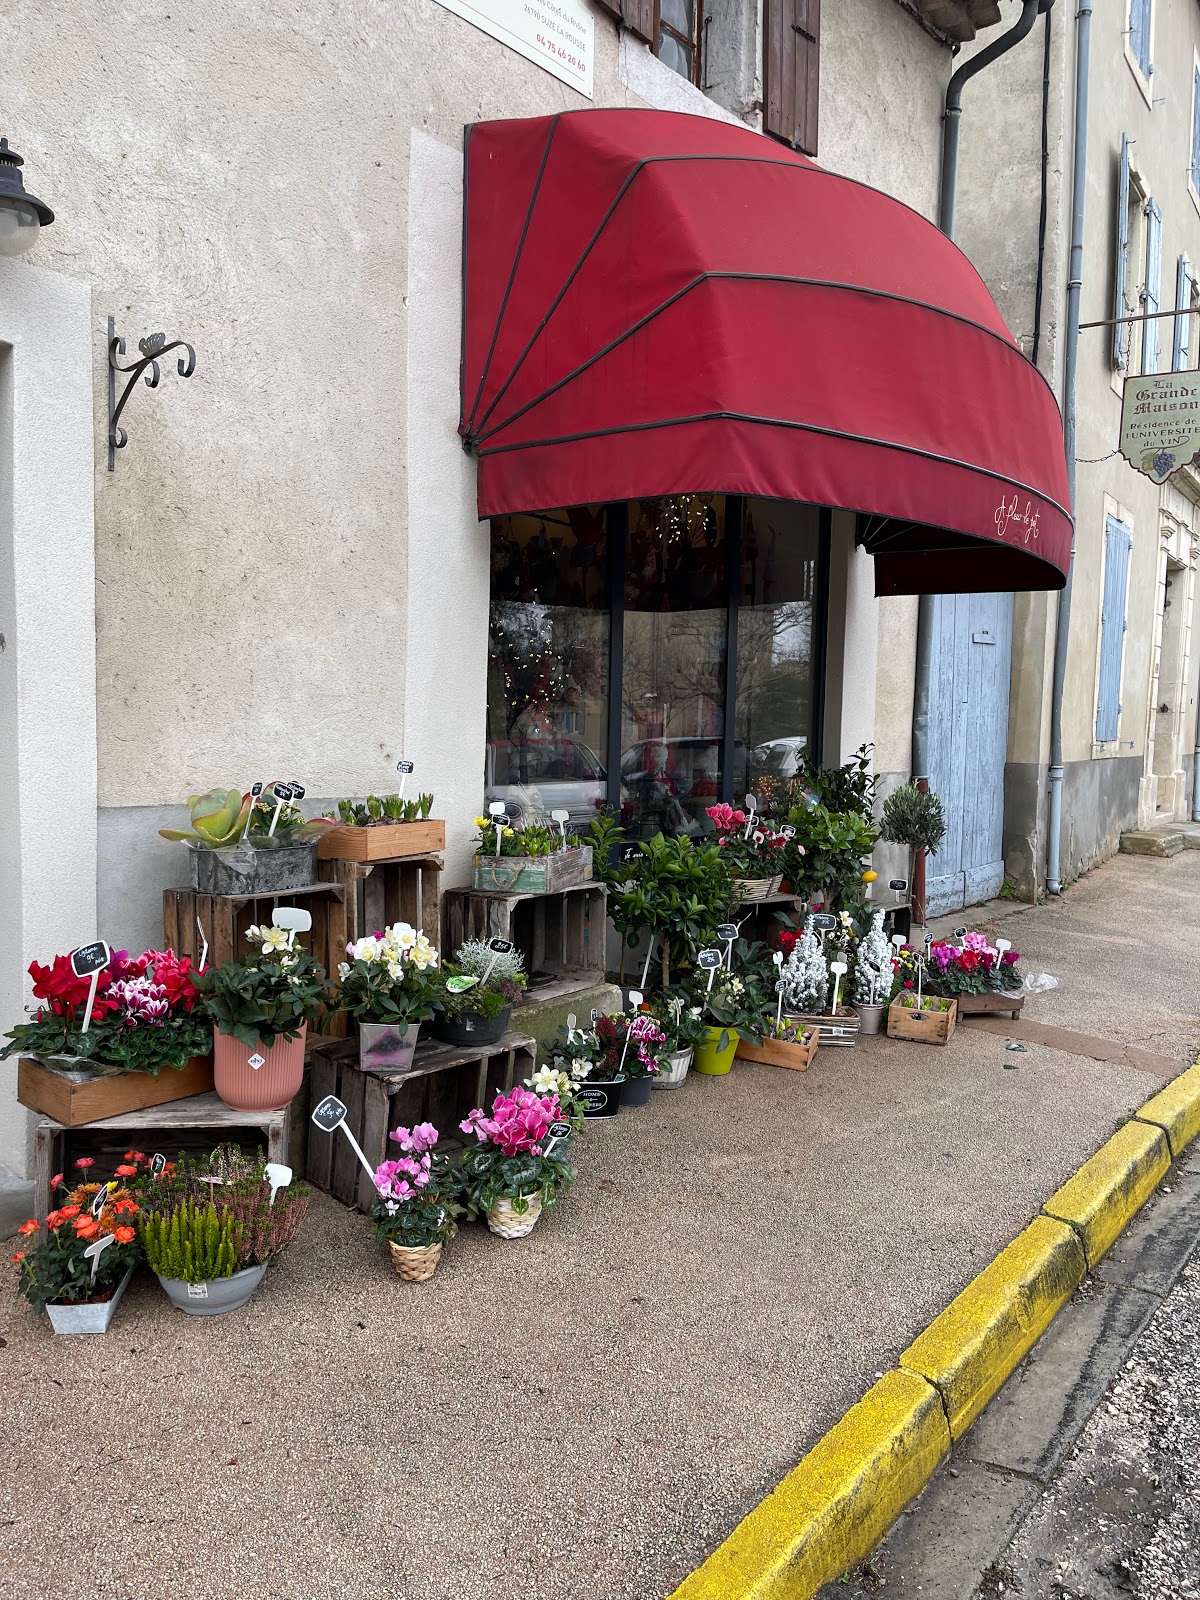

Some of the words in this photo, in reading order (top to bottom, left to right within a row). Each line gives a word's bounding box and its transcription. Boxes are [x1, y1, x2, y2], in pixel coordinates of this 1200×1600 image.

[524, 3, 540, 21] 26790
[541, 15, 556, 32] SUZE
[557, 26, 564, 37] LA
[565, 31, 586, 52] ROUSSE
[563, 13, 570, 23] du
[571, 17, 587, 35] Rhône
[536, 33, 546, 47] 04
[547, 40, 556, 54] 75
[557, 48, 567, 60] 46
[568, 54, 576, 66] 20
[577, 60, 586, 72] 60
[1153, 380, 1173, 389] La
[1136, 386, 1198, 402] Grande
[1133, 400, 1199, 415] Maison
[1160, 438, 1180, 446] VIN
